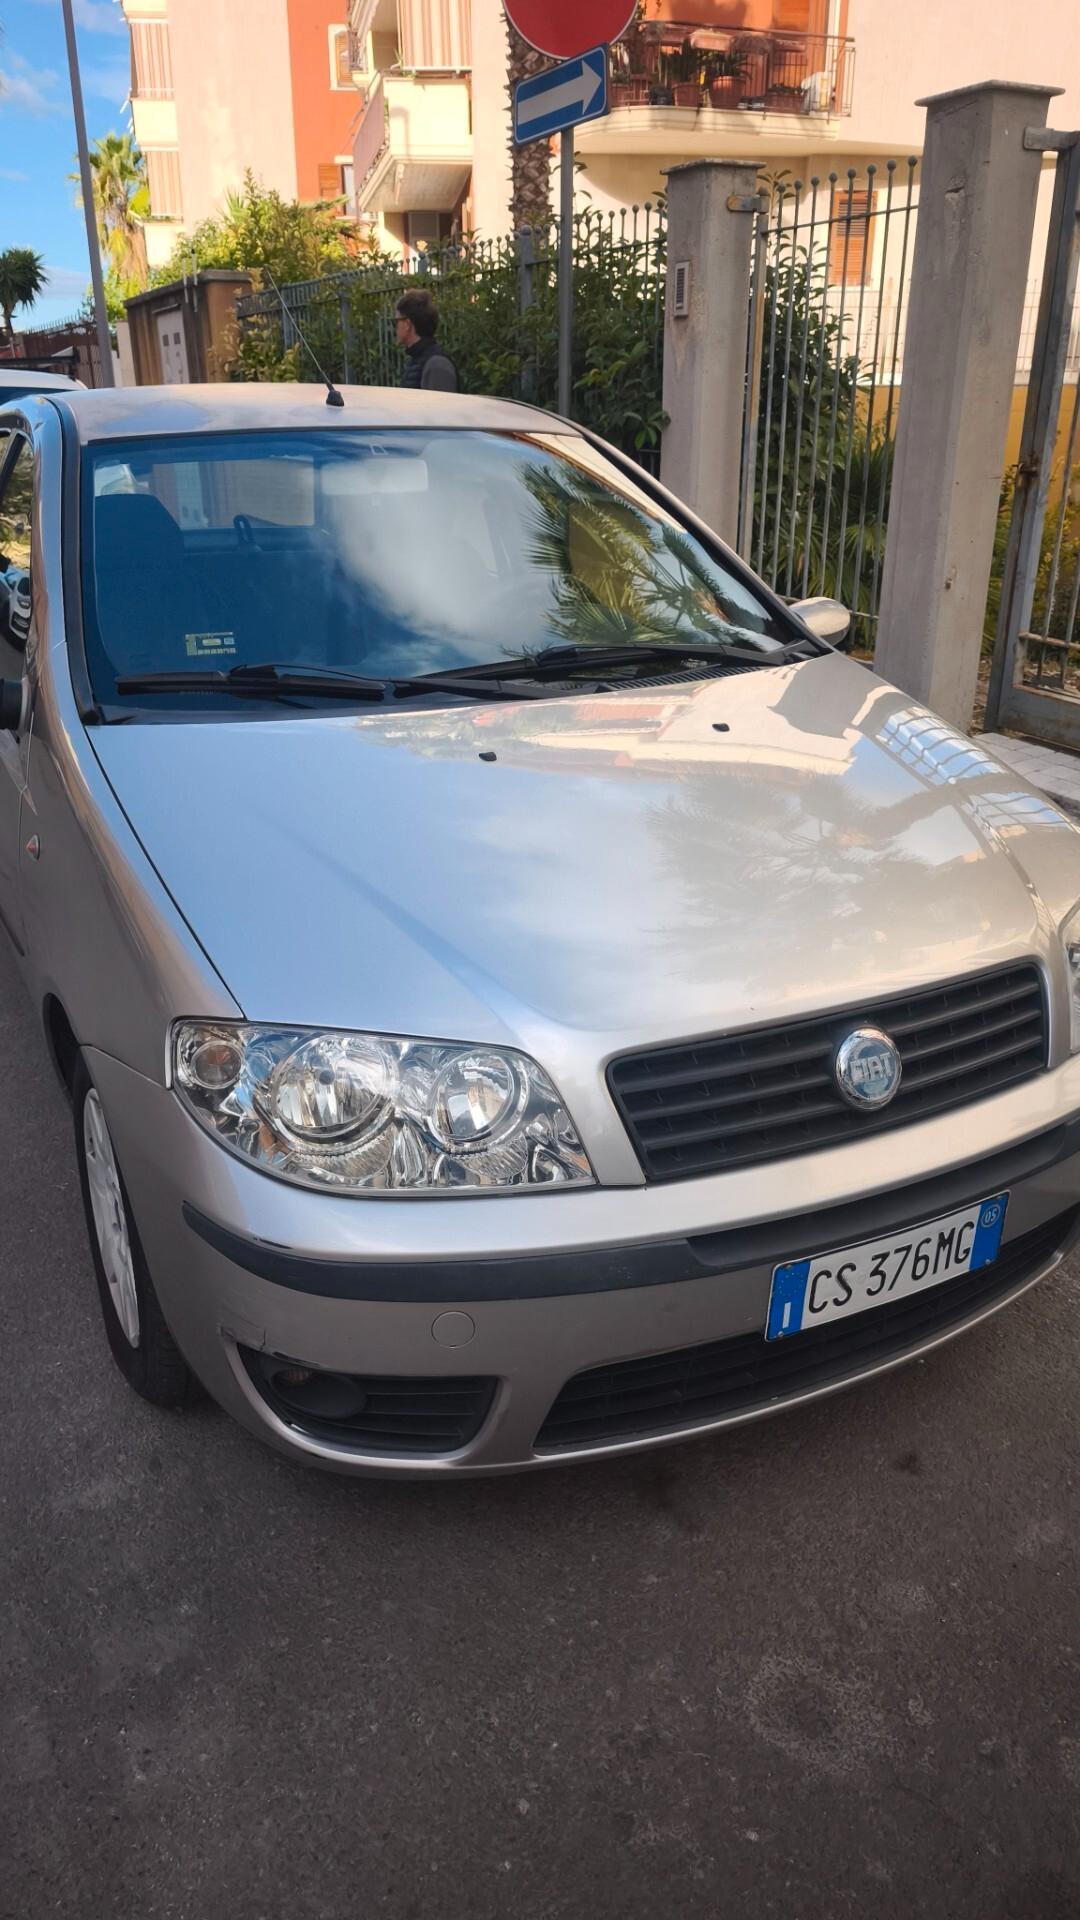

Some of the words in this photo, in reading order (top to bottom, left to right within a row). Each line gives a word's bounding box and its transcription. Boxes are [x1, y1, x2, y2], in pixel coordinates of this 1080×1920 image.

[849, 1052, 892, 1084] FIAT
[984, 1207, 998, 1222] 05
[808, 1262, 857, 1314] CS
[866, 1221, 975, 1297] 376MG
[781, 1301, 792, 1329] I
